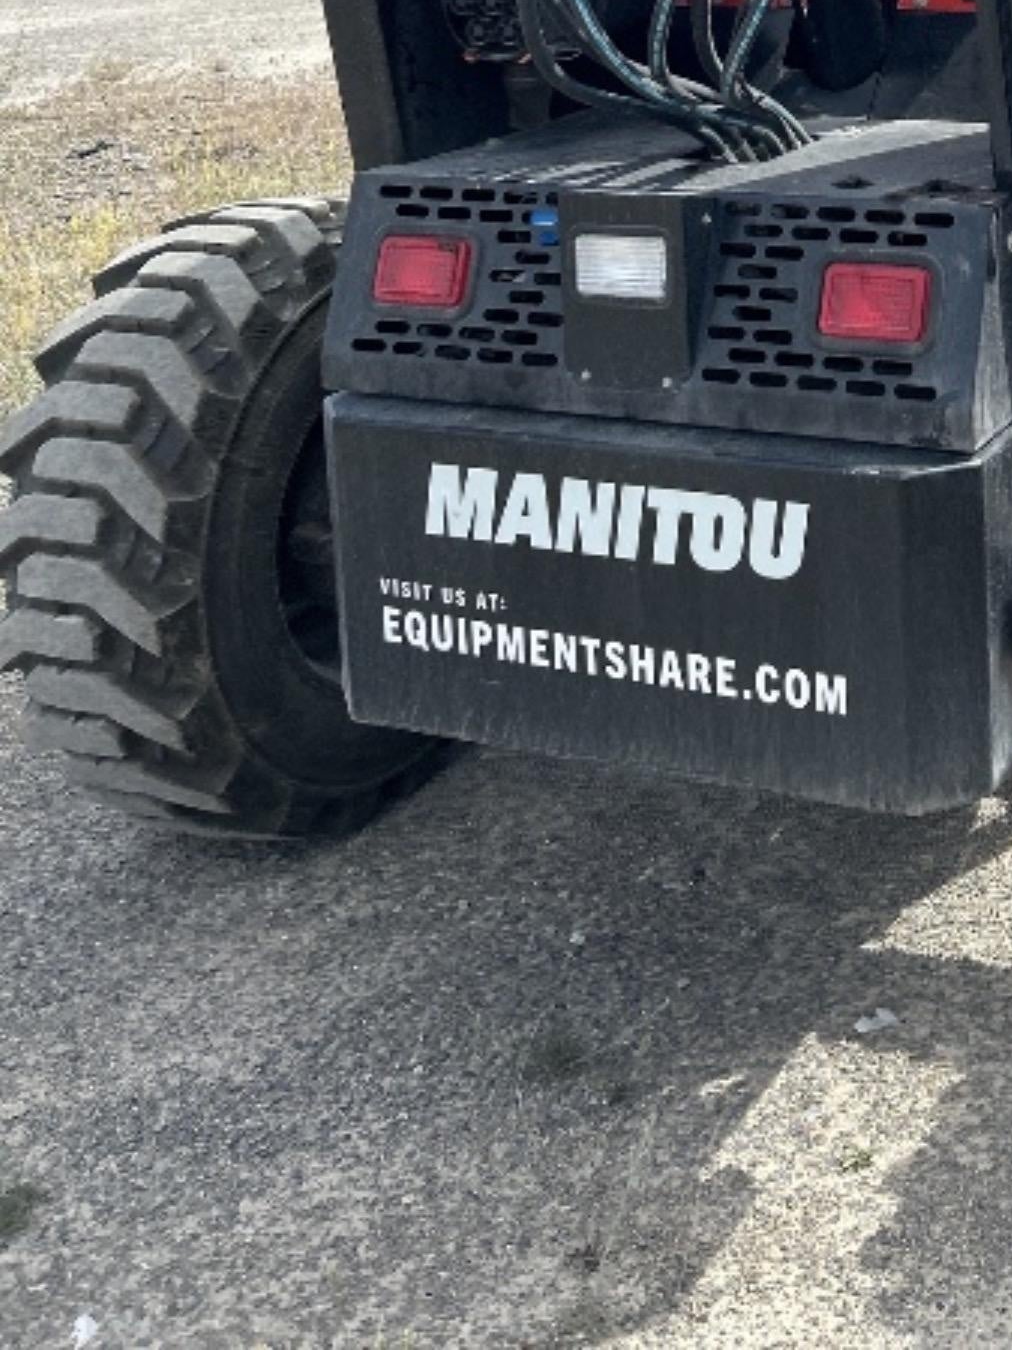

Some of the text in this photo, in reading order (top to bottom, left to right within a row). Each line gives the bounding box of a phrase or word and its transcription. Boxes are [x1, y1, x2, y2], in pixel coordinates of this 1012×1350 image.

[425, 462, 810, 581] MANITOU
[379, 577, 508, 613] VISIT US AT:
[382, 605, 848, 716] EQUIPMENTSHARE.COM
